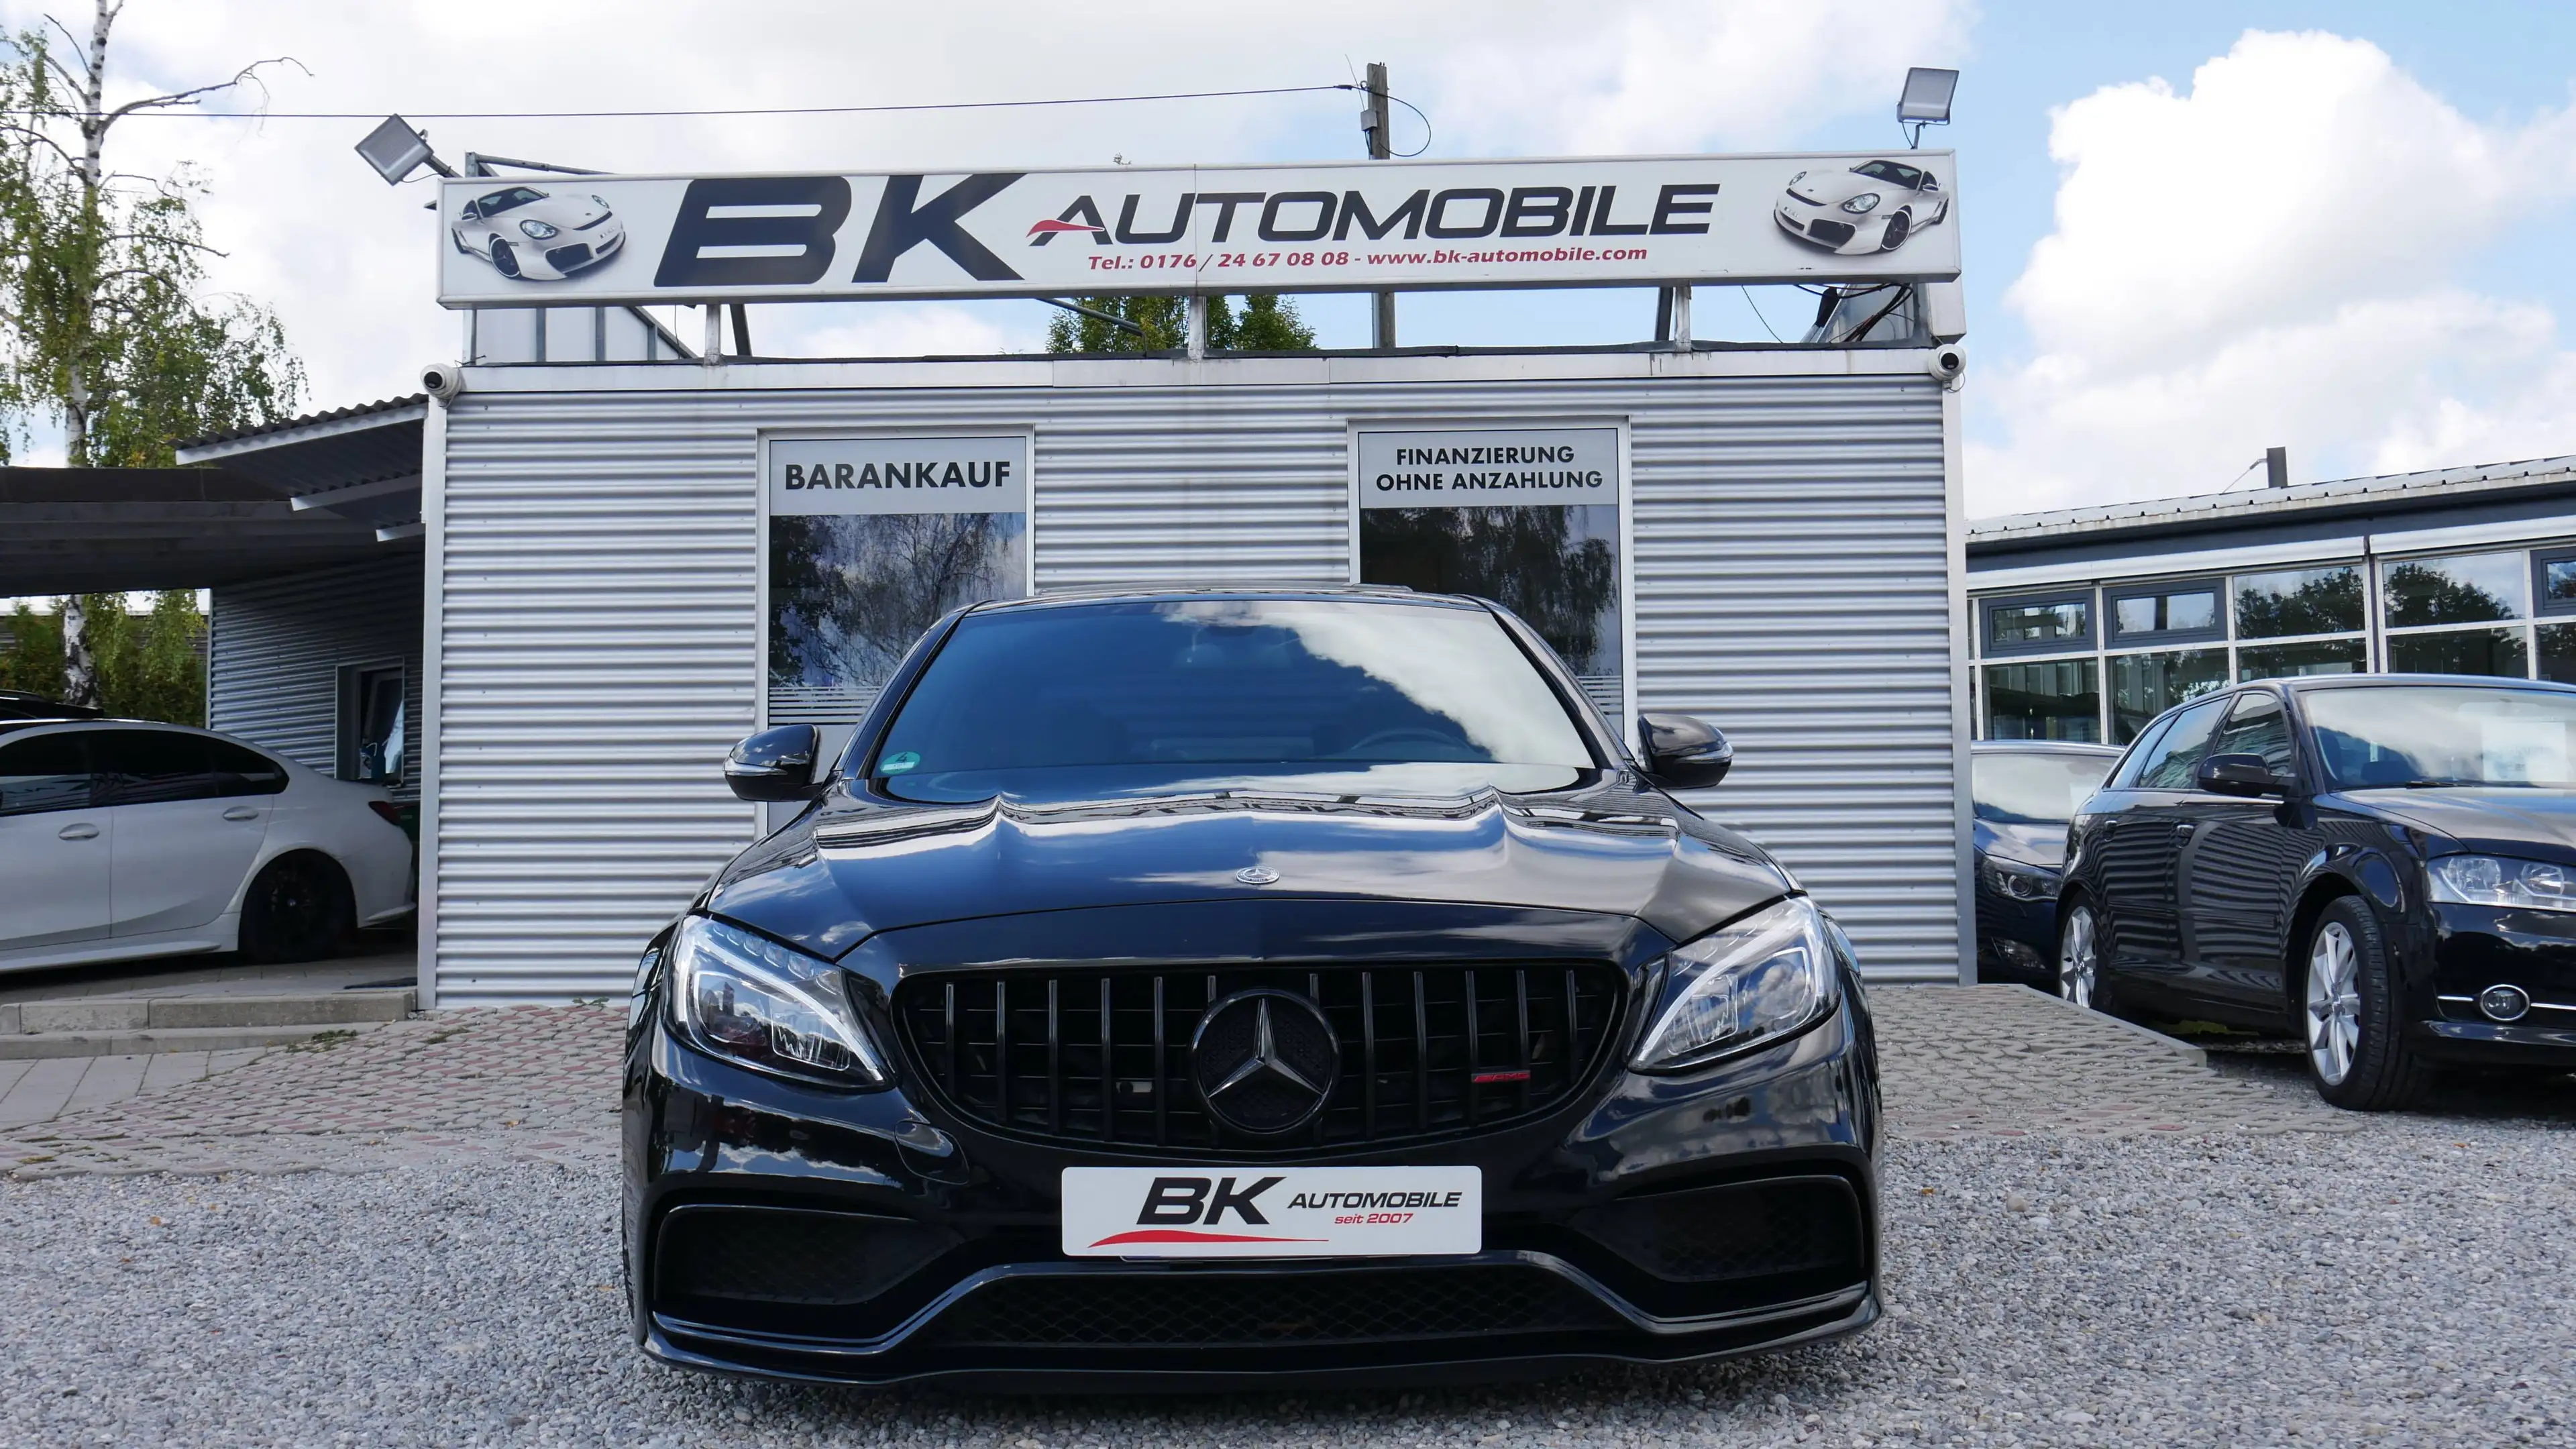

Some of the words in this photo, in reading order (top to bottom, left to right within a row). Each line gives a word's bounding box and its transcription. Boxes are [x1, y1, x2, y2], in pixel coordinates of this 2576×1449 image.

[653, 173, 1026, 287] BK
[1028, 183, 1720, 247] AUTOMOBILE
[1088, 256, 1134, 270] Tel.:
[1140, 254, 1197, 269] 0176
[1218, 252, 1246, 268] 24
[1252, 252, 1281, 267] 67
[1287, 252, 1315, 266] 08
[1321, 252, 1349, 266] 08
[1367, 247, 1648, 265] www.bk-automobile.com
[1396, 445, 1574, 466] FINANZIERUNG
[786, 461, 1010, 490] BARANKAUF
[1376, 473, 1443, 491] OHNE
[1451, 470, 1603, 490] ANZAHLUNG
[1136, 1177, 1287, 1226] BK
[1287, 1191, 1463, 1209] AUTOMOBILE
[1334, 1213, 1364, 1224] seit
[1366, 1213, 1413, 1224] 2007
